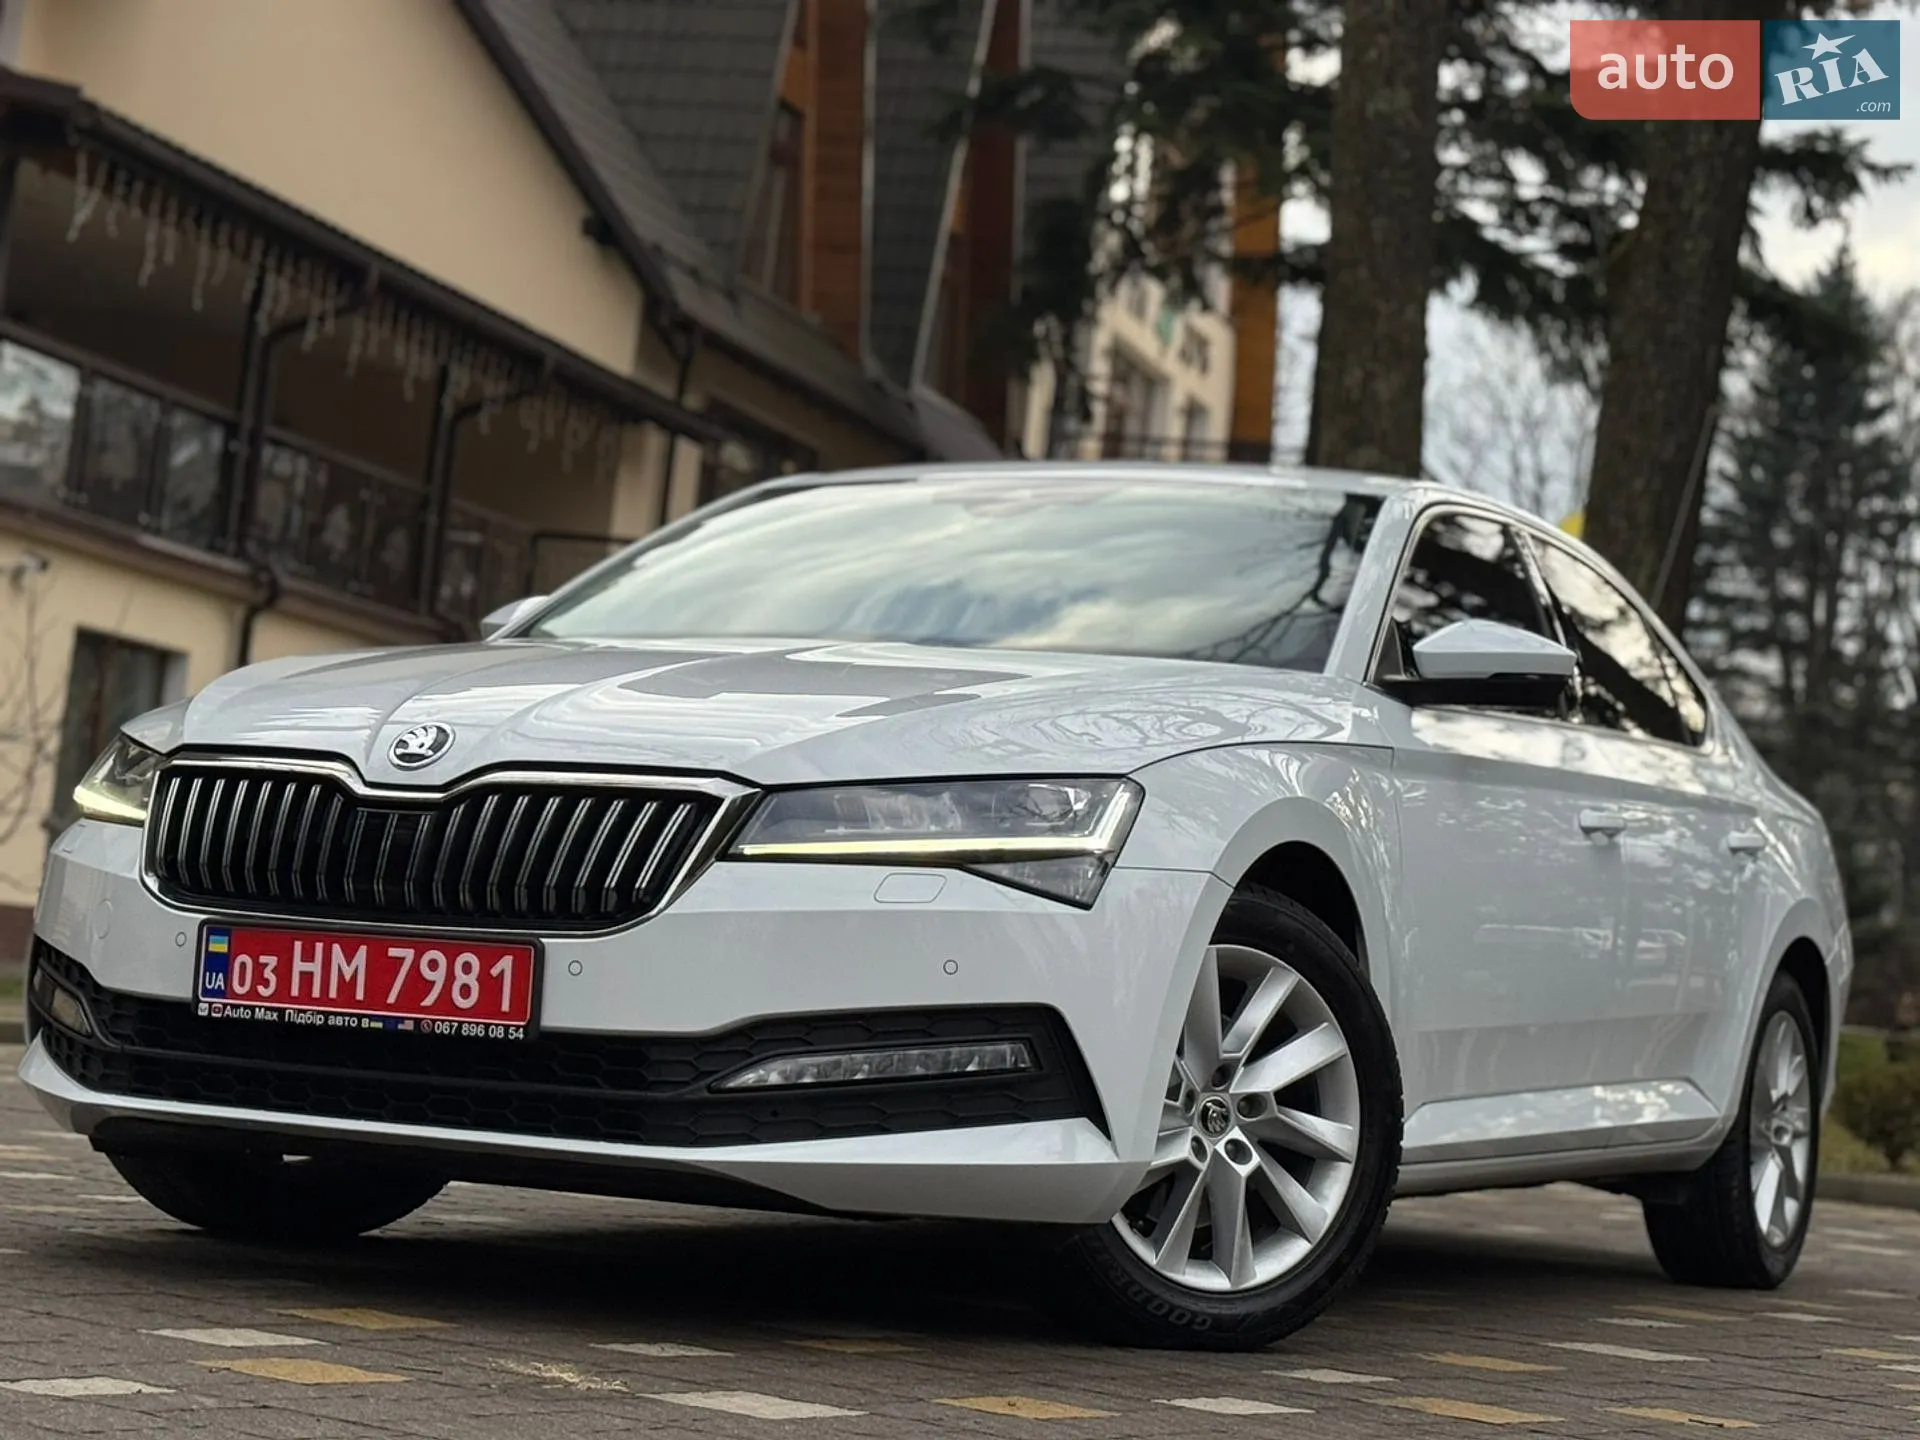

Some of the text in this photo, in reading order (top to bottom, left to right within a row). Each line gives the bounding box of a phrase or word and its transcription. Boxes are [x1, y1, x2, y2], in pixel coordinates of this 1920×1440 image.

[205, 972, 225, 991] UA
[231, 940, 514, 1013] 03 HM 7981
[223, 1005, 252, 1021] Auto
[254, 1007, 279, 1021] Max
[285, 1009, 324, 1026] Підбір
[327, 1015, 359, 1028] авто
[434, 1021, 459, 1036] 067
[461, 1022, 486, 1038] 896
[488, 1025, 505, 1039] 08
[507, 1026, 525, 1040] 54
